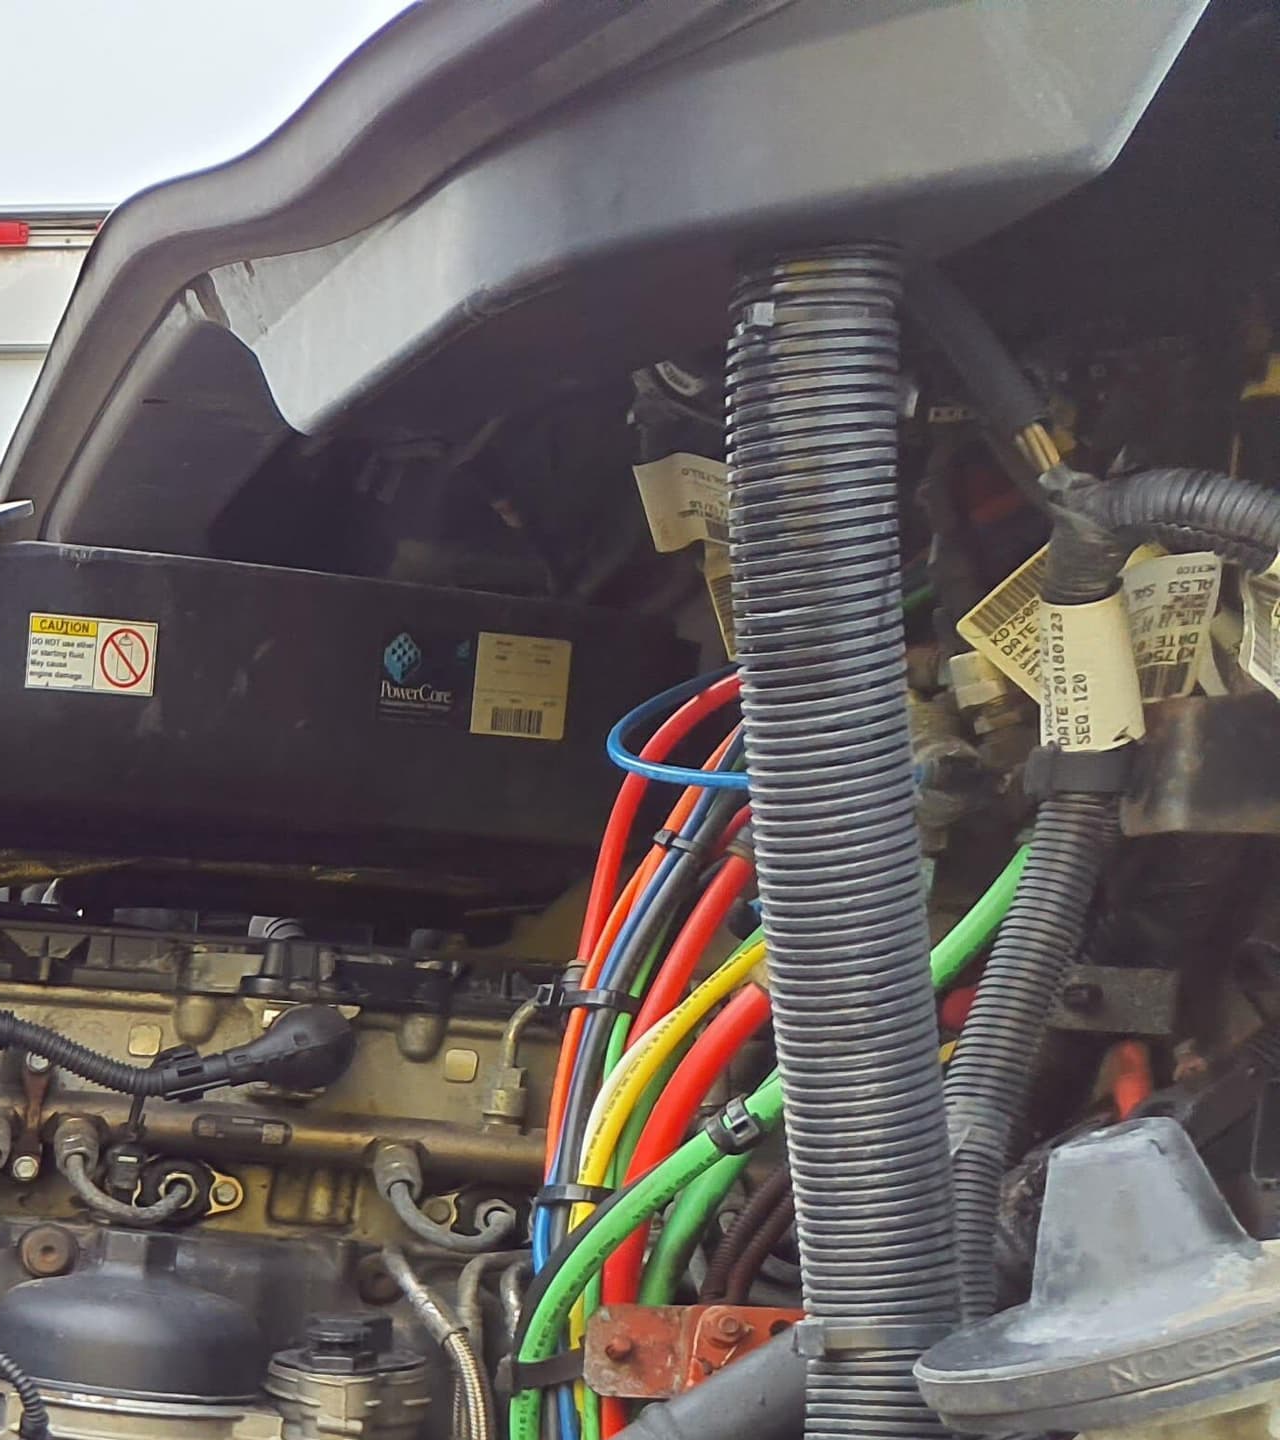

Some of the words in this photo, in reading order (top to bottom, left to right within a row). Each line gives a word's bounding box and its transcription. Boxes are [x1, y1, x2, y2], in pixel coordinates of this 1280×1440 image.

[40, 619, 89, 633] CAUTION
[45, 638, 61, 646] NOT
[381, 680, 452, 703] PowerCore
